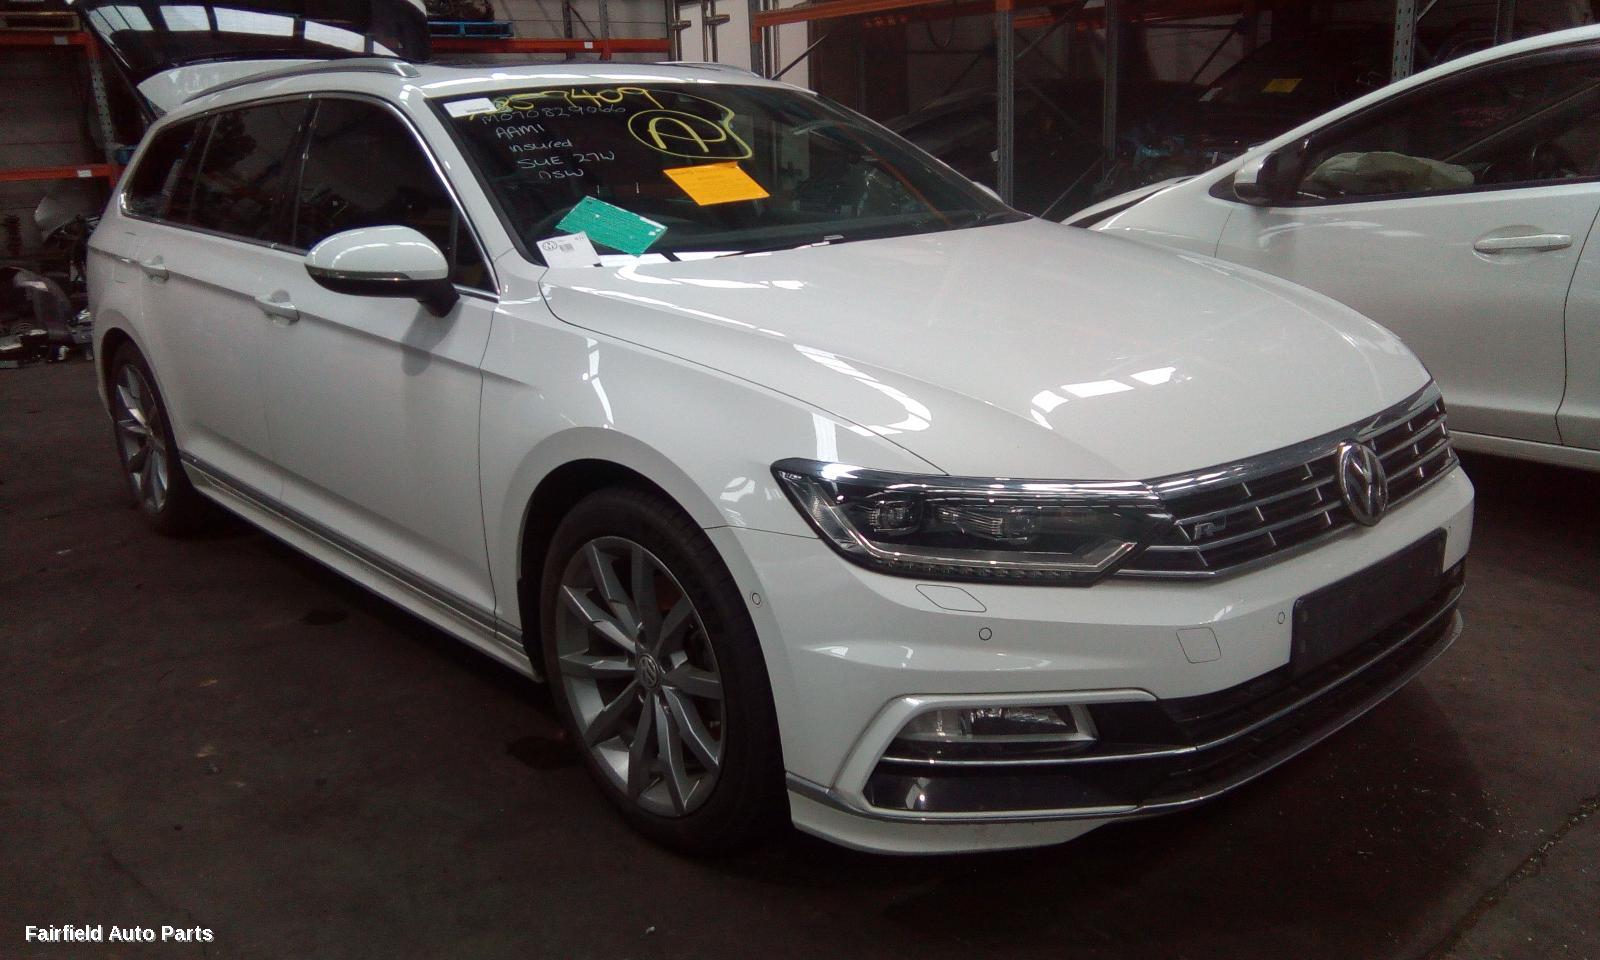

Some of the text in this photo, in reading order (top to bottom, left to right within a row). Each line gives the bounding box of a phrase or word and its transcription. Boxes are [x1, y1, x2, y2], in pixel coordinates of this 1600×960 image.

[495, 123, 545, 140] AAMI
[509, 139, 573, 152] insured
[517, 156, 565, 168] SUE
